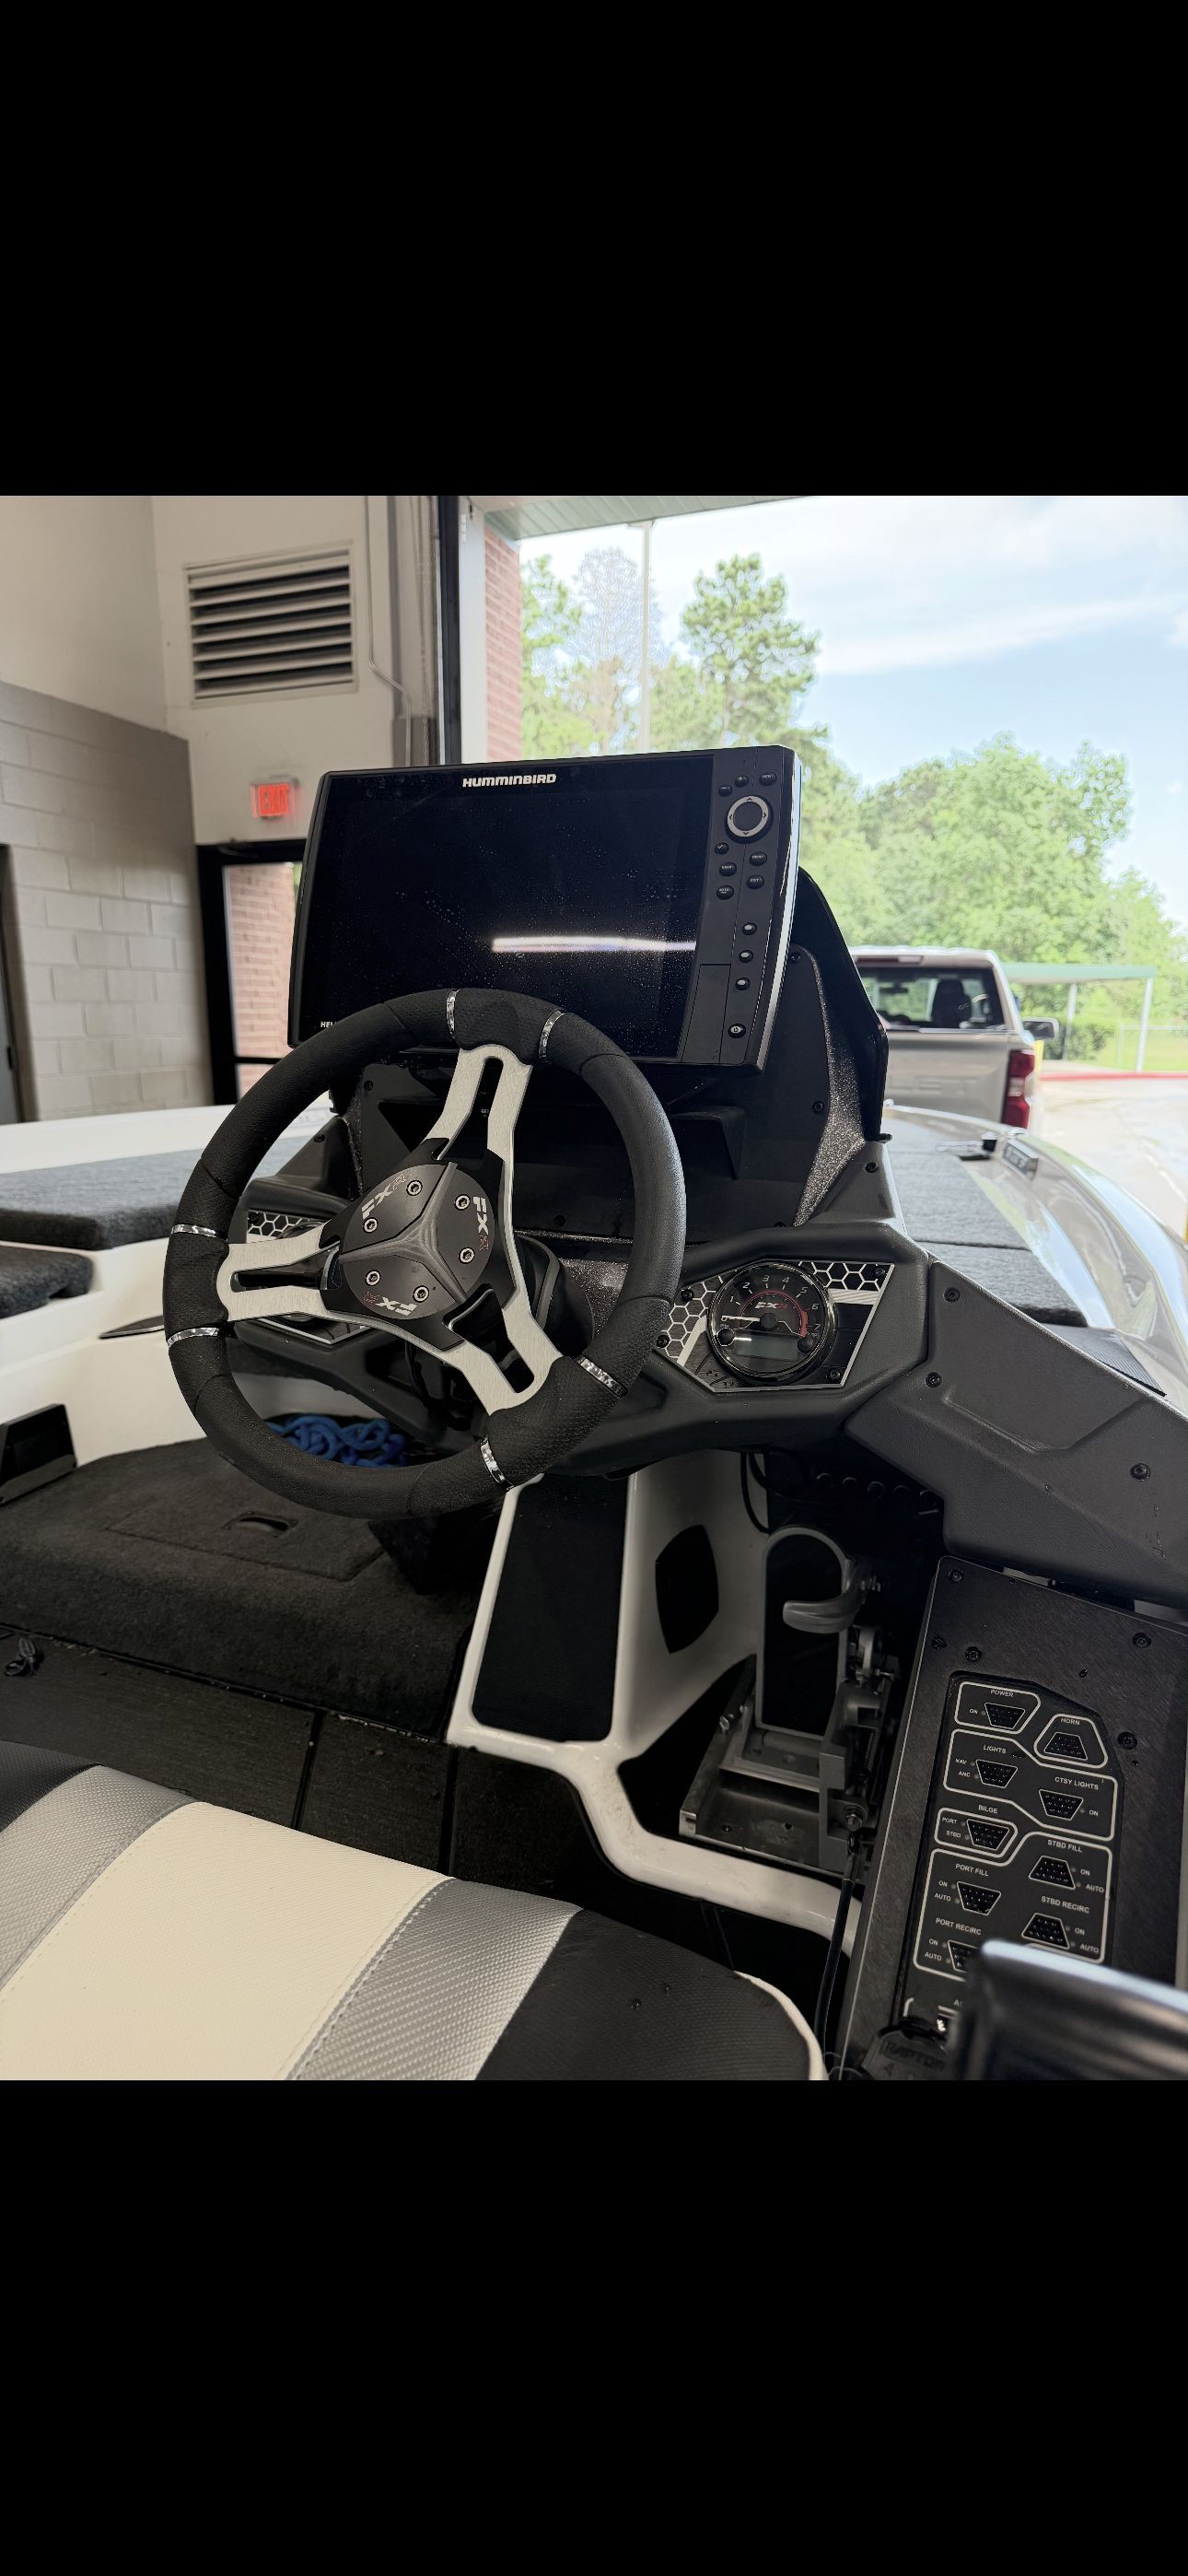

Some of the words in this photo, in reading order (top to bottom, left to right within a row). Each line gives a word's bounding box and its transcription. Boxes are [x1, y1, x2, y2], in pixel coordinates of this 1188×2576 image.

[462, 774, 557, 787] HUMMINBIRD
[762, 1274, 770, 1282] 3
[782, 1276, 790, 1284] 4
[990, 1689, 1014, 1697] POWER
[1060, 1716, 1080, 1726] HORN
[983, 1744, 1007, 1754] LIGHTS
[1054, 1776, 1073, 1786] CTSY
[1074, 1780, 1099, 1790] LIGHTS
[978, 1804, 998, 1814] BILGE
[946, 1830, 961, 1838] STBD
[1047, 1839, 1066, 1849] STBD
[1067, 1844, 1083, 1853] FILL
[955, 1863, 974, 1873] PORT
[974, 1868, 989, 1877] FILL
[938, 1879, 949, 1888] ON
[1085, 1883, 1105, 1893] AUTO
[934, 1892, 951, 1902] AUTO
[1041, 1895, 1061, 1906] STBD
[1062, 1901, 1090, 1914] RECIRC
[935, 1917, 955, 1928] PORT
[955, 1923, 982, 1936] RECIRC
[1074, 1926, 1085, 1936] ON
[1079, 1943, 1100, 1953] AUTO
[924, 1951, 942, 1961] AUTO
